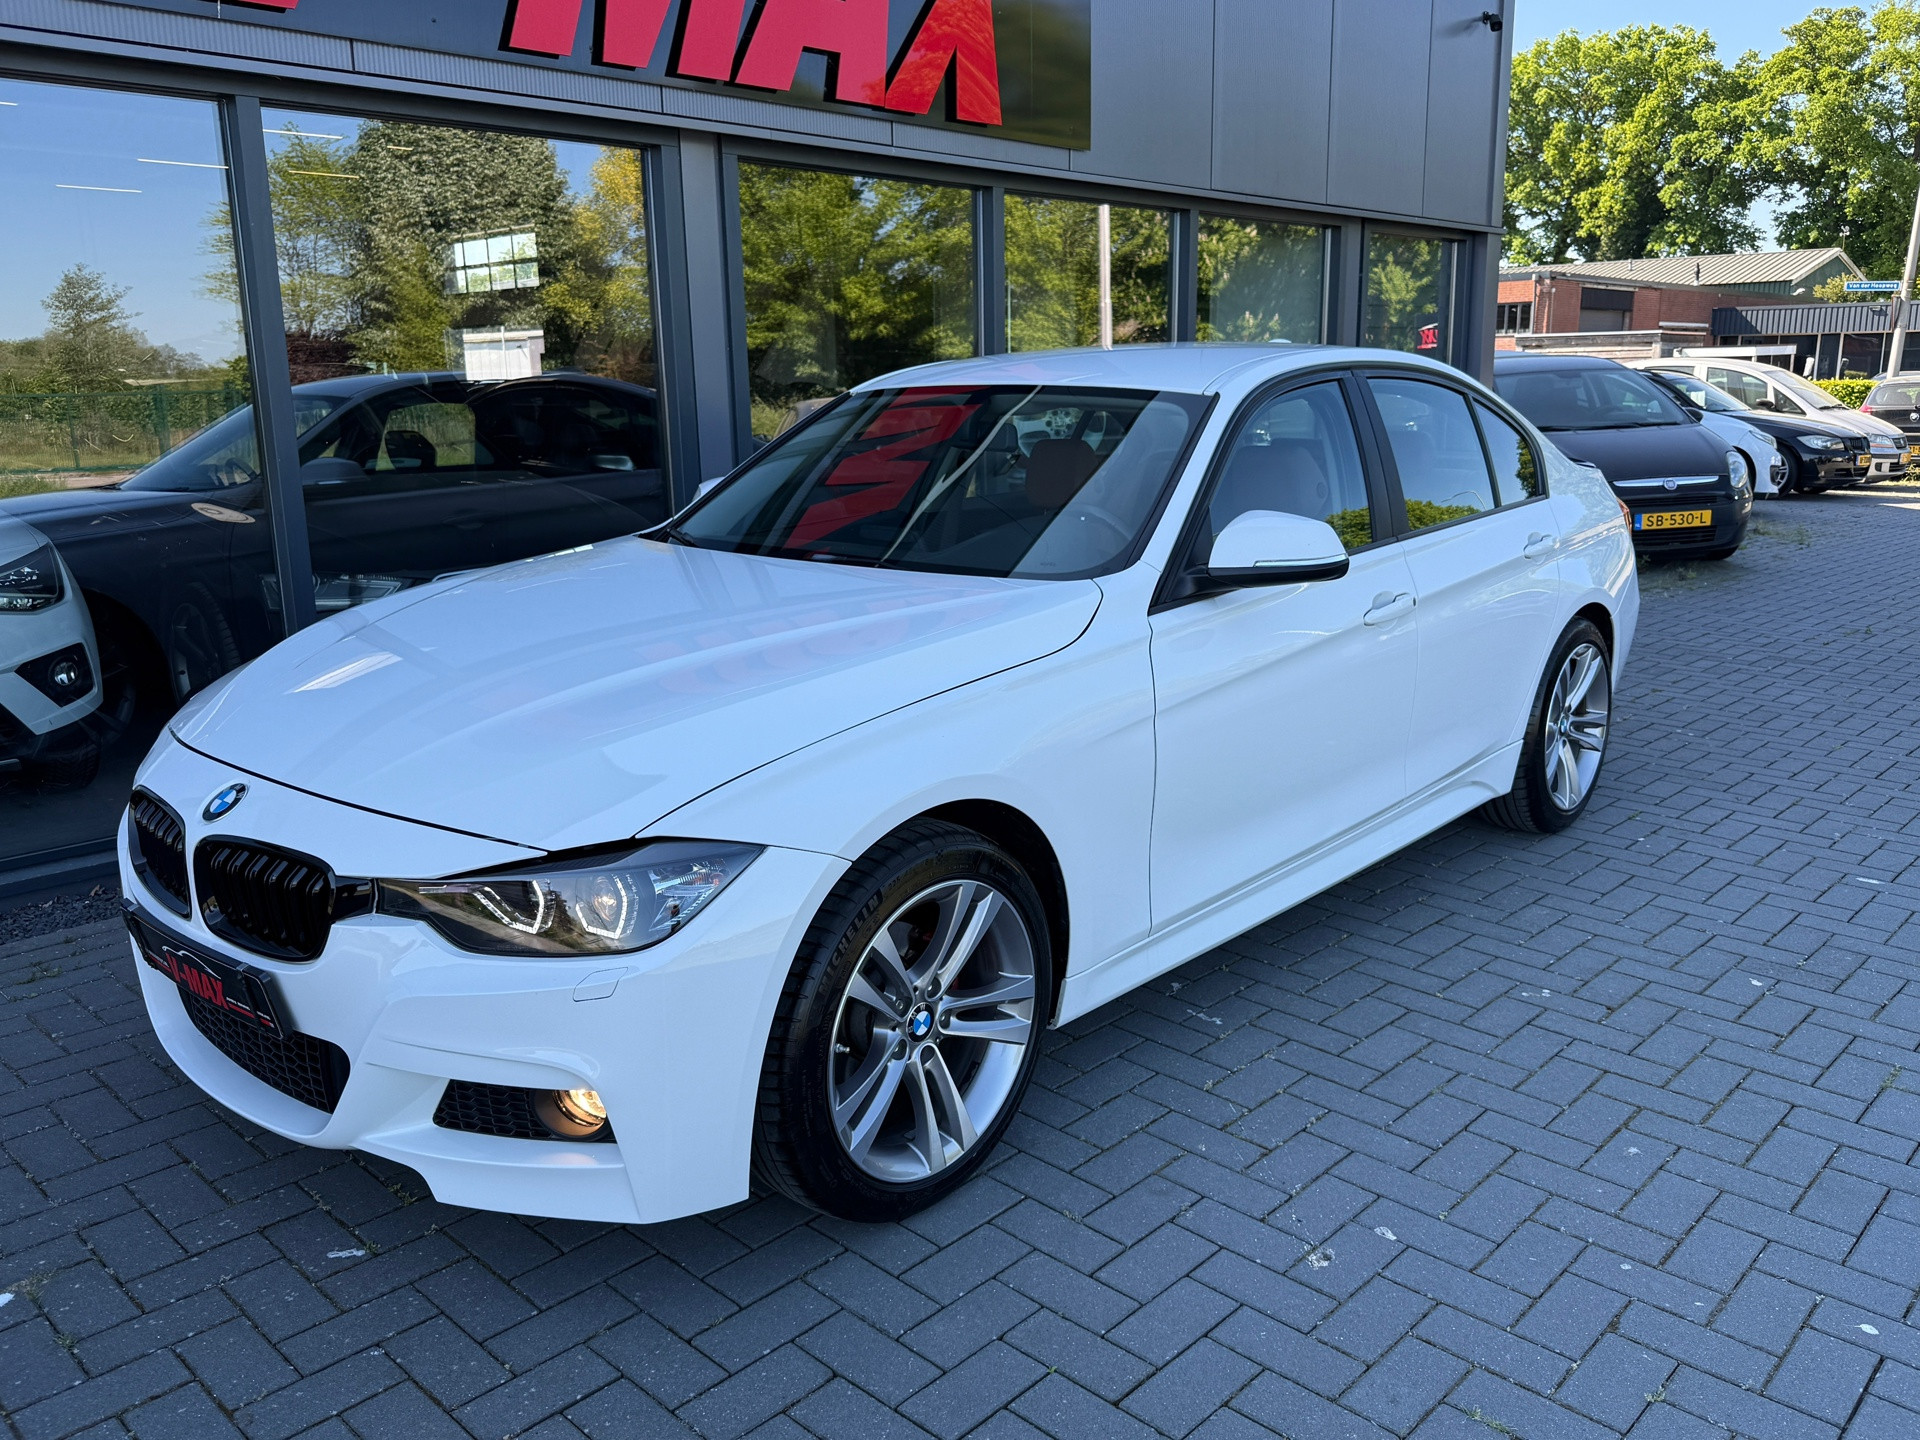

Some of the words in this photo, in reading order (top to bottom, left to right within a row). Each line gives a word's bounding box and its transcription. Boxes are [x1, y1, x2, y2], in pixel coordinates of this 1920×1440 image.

[1646, 512, 1706, 527] SB-530-L
[818, 893, 881, 997] MICHELIN
[165, 952, 230, 1010] V-MAX
